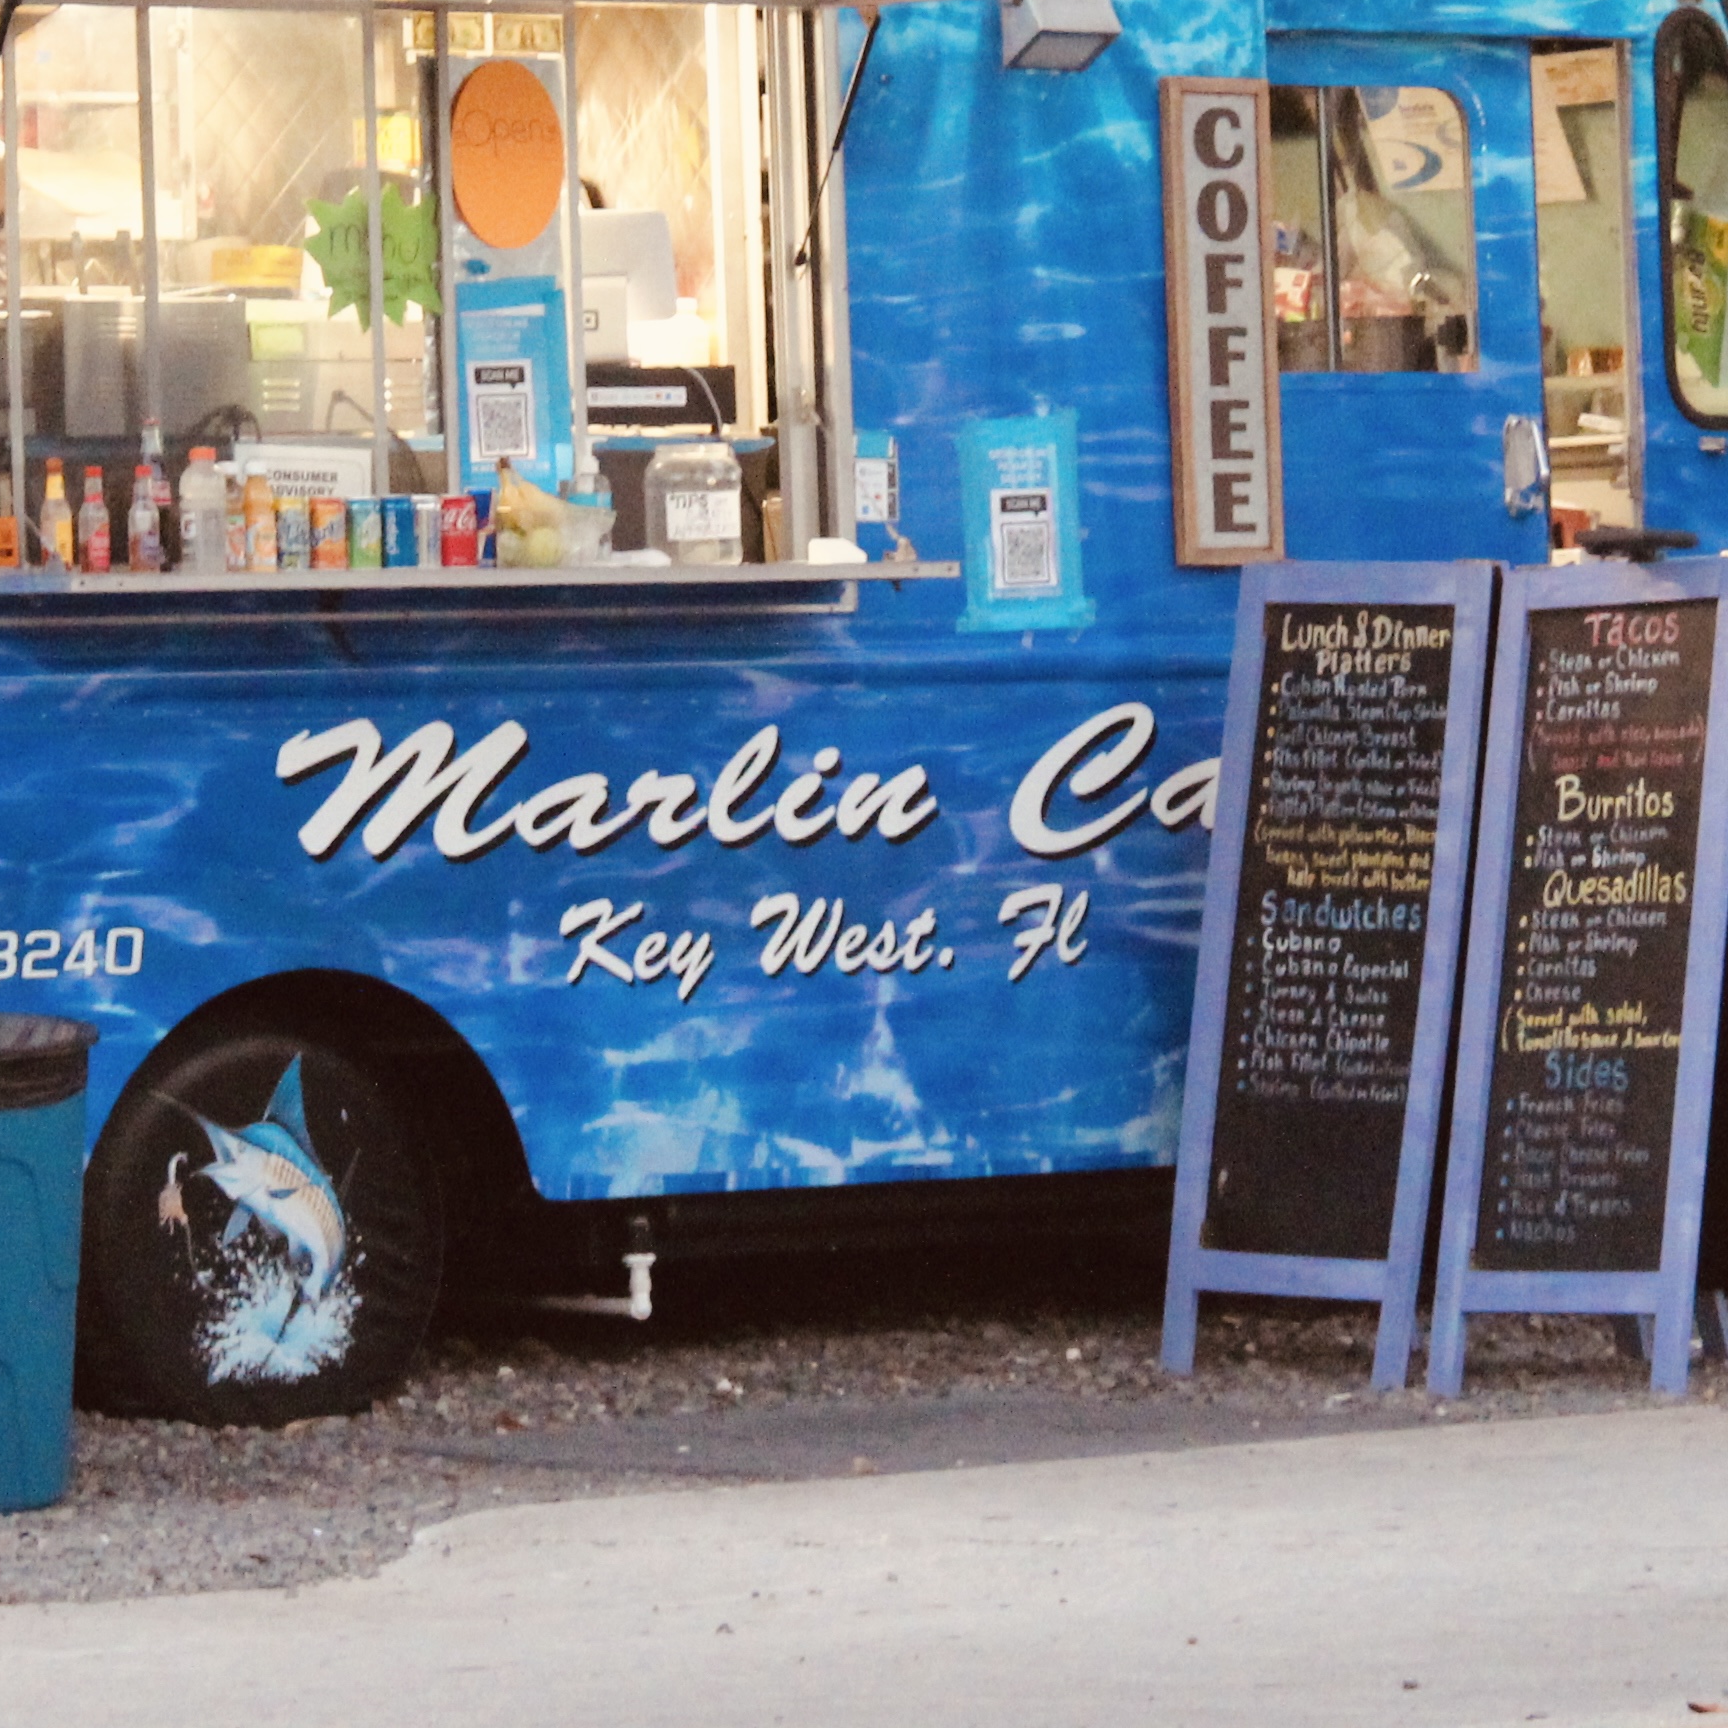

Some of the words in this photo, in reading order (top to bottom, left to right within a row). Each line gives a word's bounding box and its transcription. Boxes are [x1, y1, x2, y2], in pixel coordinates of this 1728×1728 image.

[1193, 108, 1256, 533] COFFEE
[1281, 612, 1349, 651] Lunch
[1372, 614, 1451, 650] Dinner
[1316, 649, 1412, 675] Platters
[276, 718, 940, 861] Marlin
[1009, 702, 1220, 857] Ca
[1555, 774, 1674, 821] Burritos
[1543, 863, 1687, 908] Quesadillas
[1260, 889, 1422, 931] Sandwiches
[559, 898, 714, 1000] Key
[750, 894, 956, 975] West.
[998, 883, 1089, 981] Fl
[1262, 927, 1342, 953] Cubano
[1262, 952, 1338, 977] Cubano
[1545, 1049, 1629, 1092] Sides
